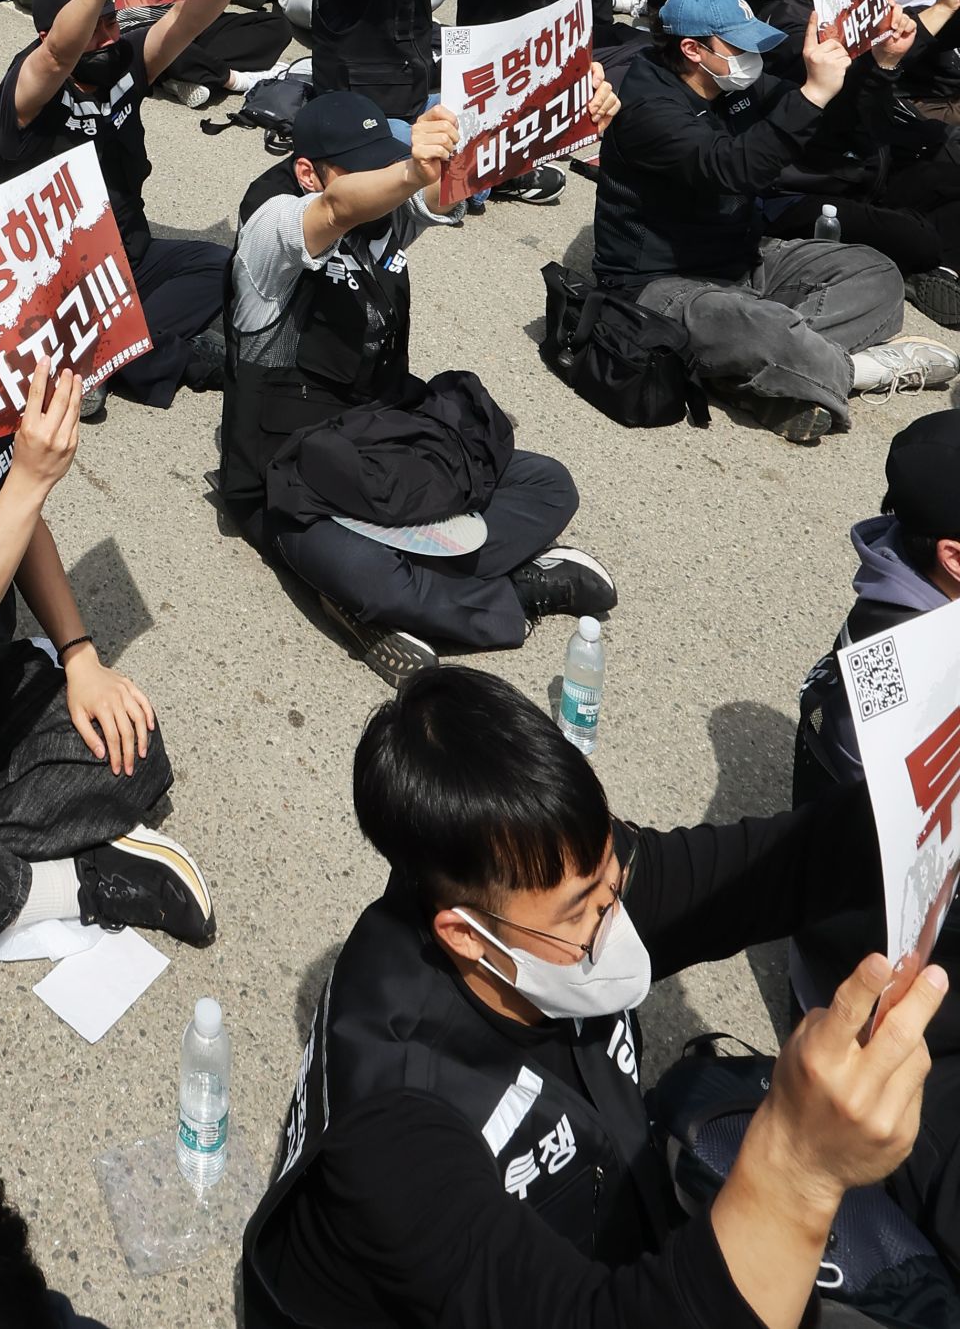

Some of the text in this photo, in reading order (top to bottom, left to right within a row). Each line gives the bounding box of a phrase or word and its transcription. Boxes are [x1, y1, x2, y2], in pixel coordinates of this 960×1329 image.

[65, 116, 97, 136] 투쟁
[113, 102, 132, 131] SELU
[476, 74, 594, 179] 바꾸고!!!
[505, 1113, 578, 1200] 투쟁
